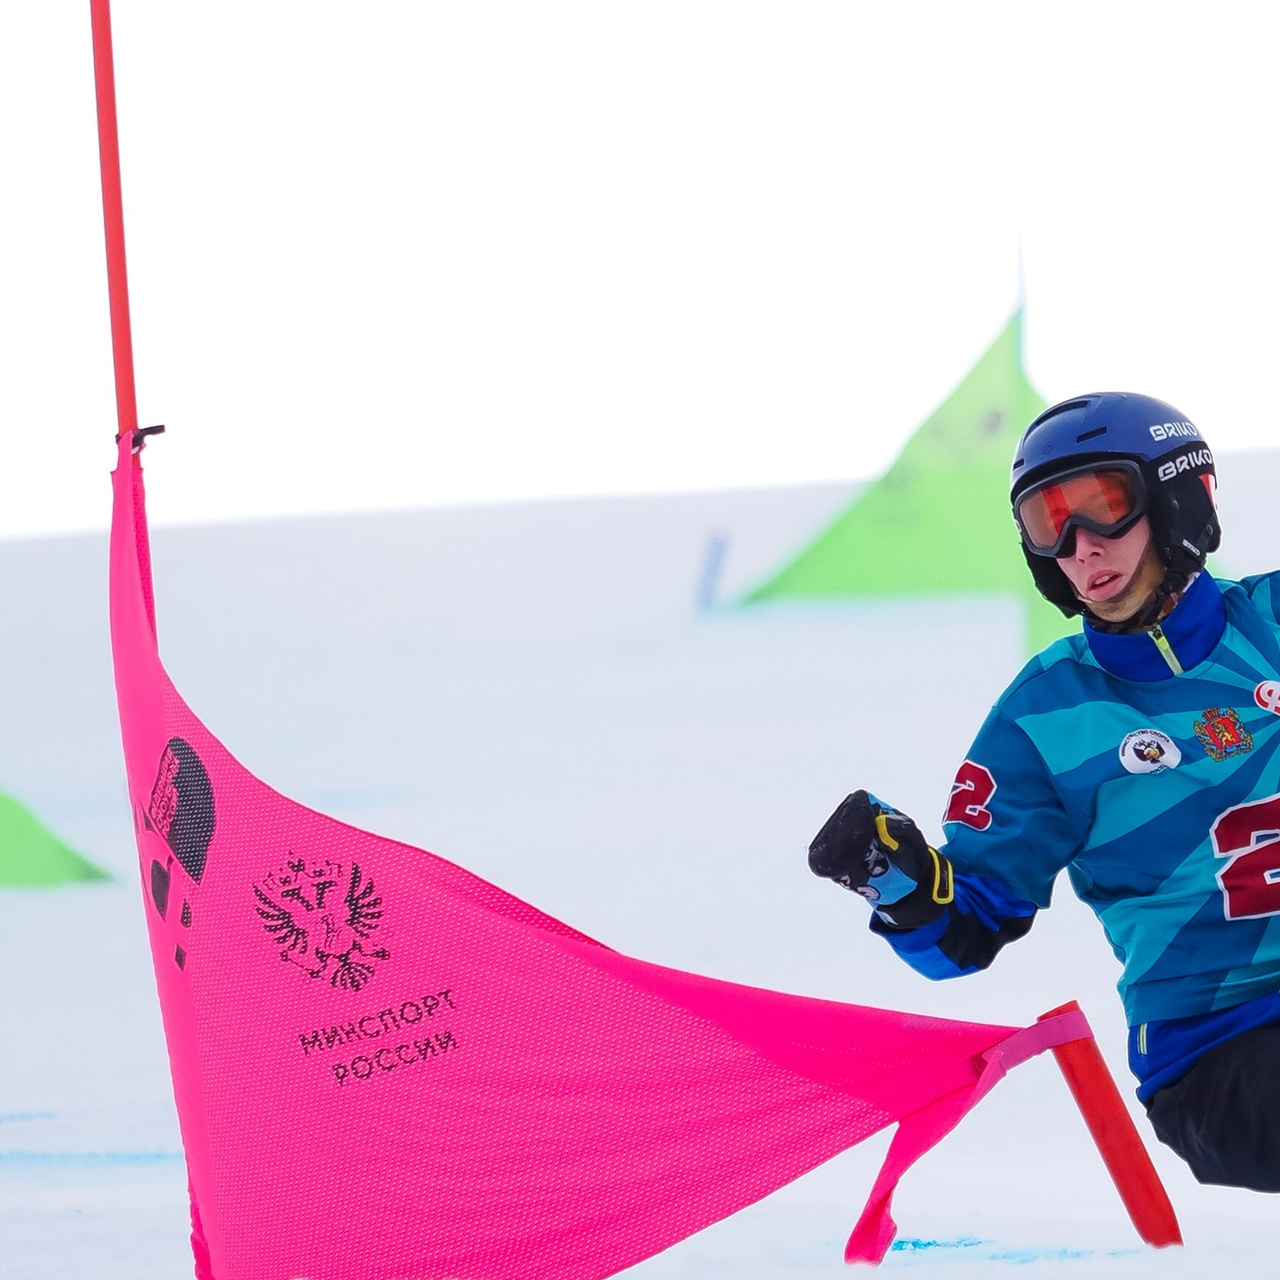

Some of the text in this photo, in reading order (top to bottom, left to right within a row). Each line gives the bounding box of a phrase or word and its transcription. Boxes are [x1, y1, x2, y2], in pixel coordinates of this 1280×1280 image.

[1149, 421, 1198, 442] BRIKO
[1157, 449, 1213, 482] BRIKO
[942, 759, 998, 832] 2
[298, 989, 457, 1057] МИНСПОРТ
[332, 1029, 460, 1087] РОССИИ
